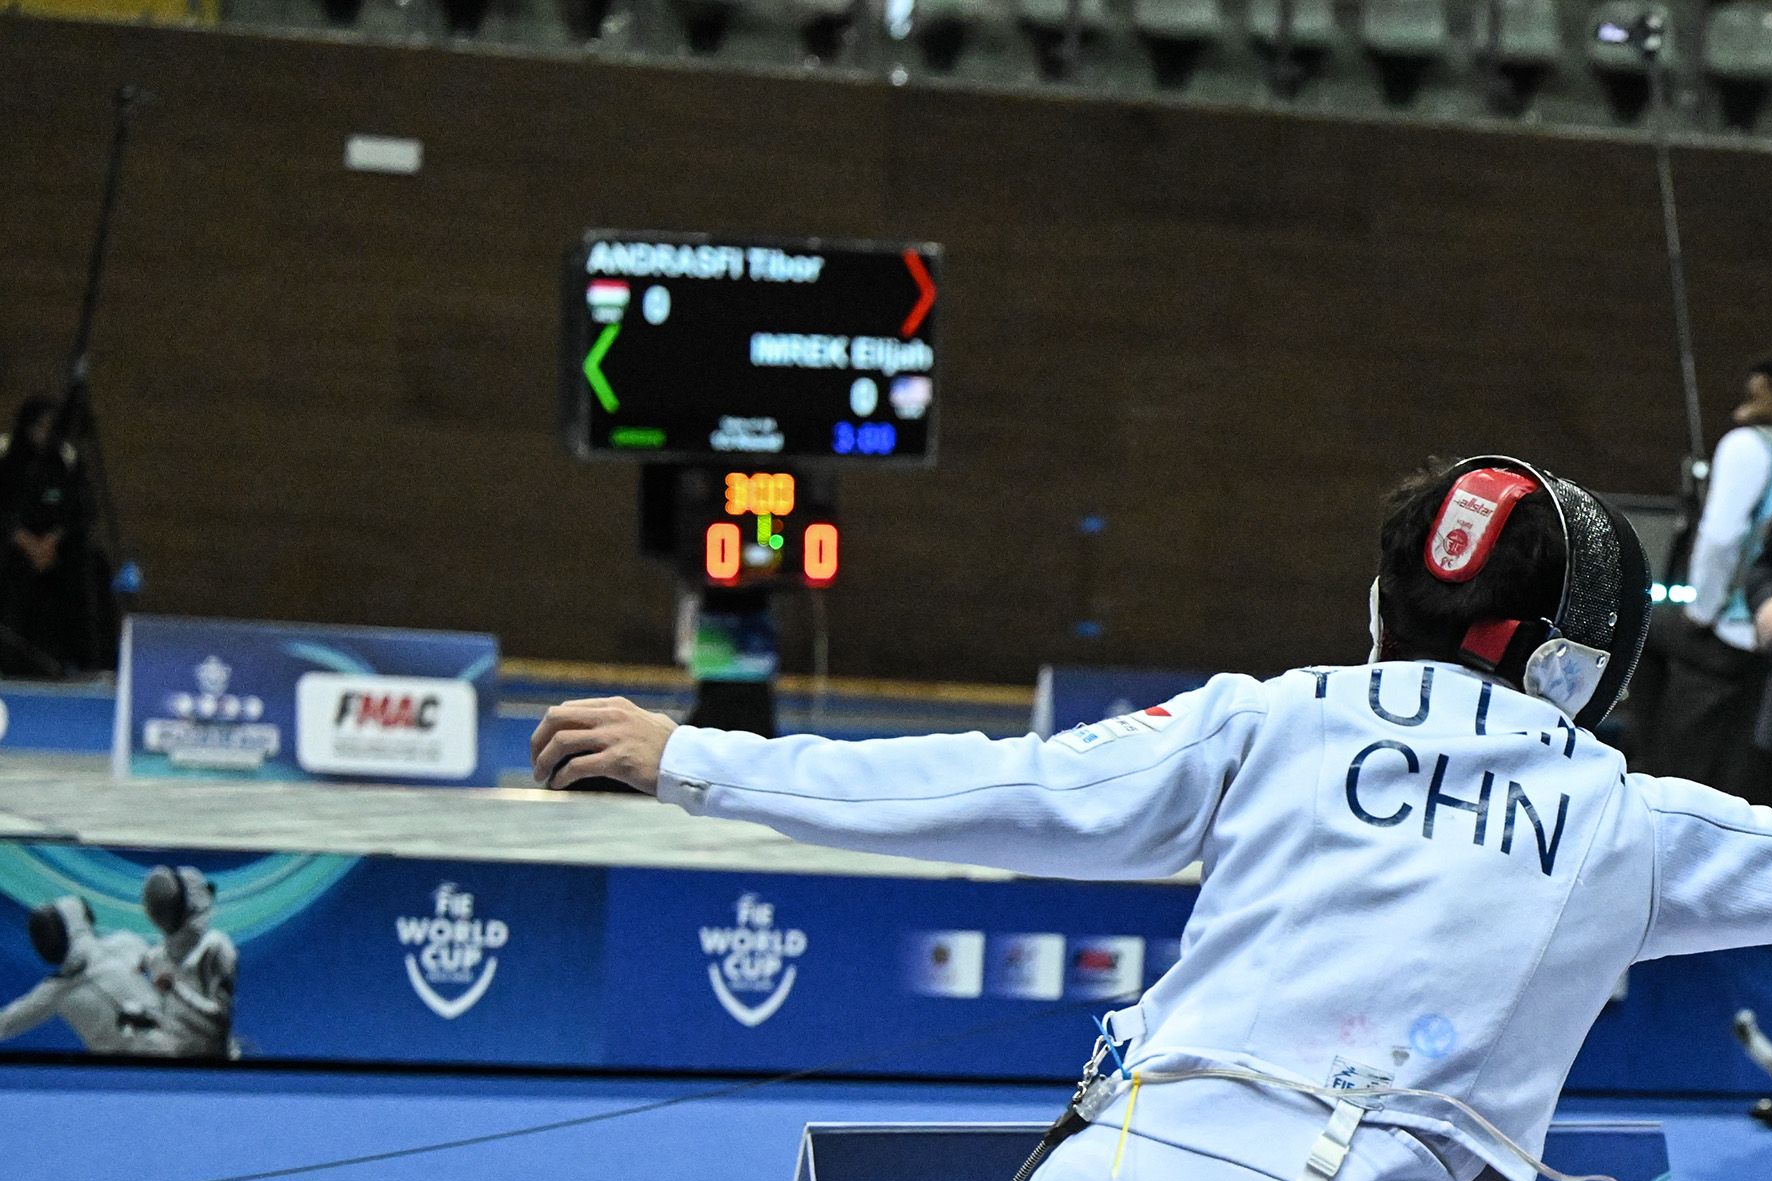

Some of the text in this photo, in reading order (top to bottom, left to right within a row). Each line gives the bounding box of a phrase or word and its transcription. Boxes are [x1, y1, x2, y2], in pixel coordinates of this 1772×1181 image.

[586, 241, 825, 283] ANDRASFI Tibor
[643, 285, 671, 325] 0
[850, 377, 878, 417] 0
[1459, 497, 1494, 518] allstar
[706, 522, 741, 580] 0
[804, 523, 838, 580] 0
[334, 691, 440, 730] FMAC
[1345, 739, 1571, 877] CHN
[397, 915, 509, 949] WORLD
[699, 926, 808, 958] WORLD
[420, 943, 482, 972] CUP
[723, 953, 782, 981] CUP
